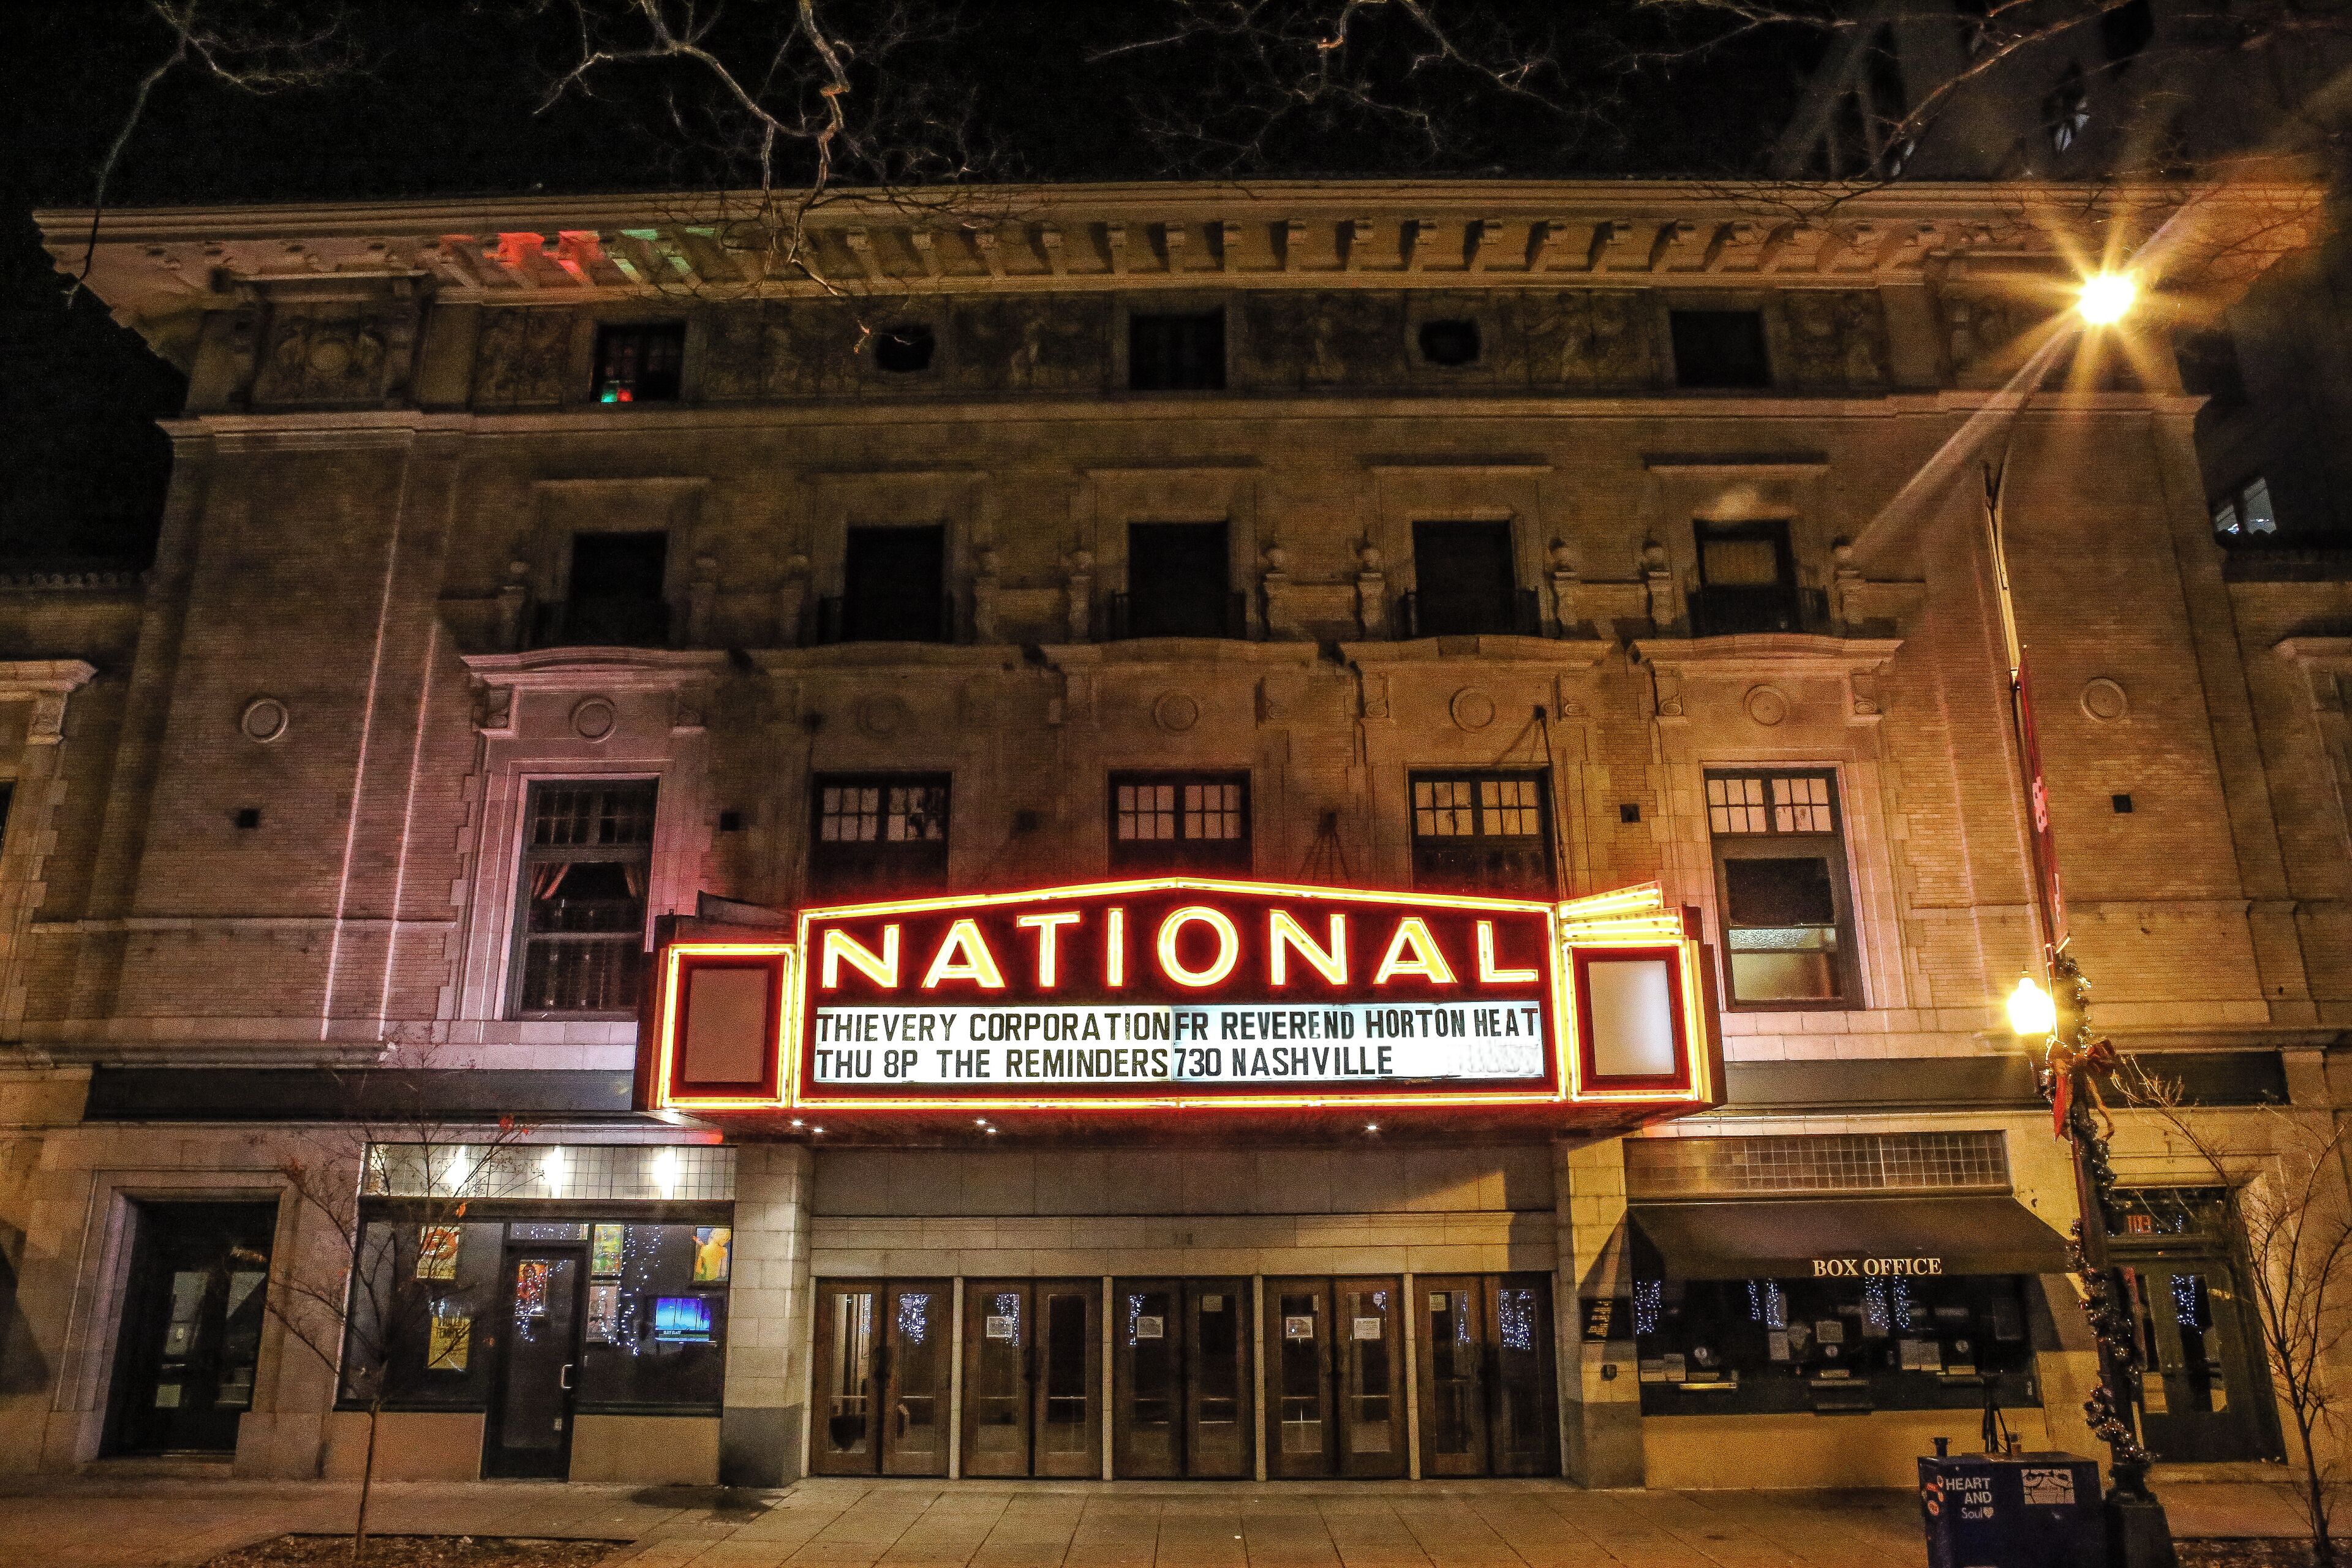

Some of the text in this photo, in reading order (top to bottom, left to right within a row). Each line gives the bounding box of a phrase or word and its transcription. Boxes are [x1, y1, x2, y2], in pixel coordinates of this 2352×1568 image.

[821, 905, 1539, 989] NATIONAL
[816, 1012, 1170, 1042] THIEVERY CORPORATION
[1175, 1008, 1539, 1040] FR REVEREND HORTON HEAT
[816, 1048, 1168, 1078] THU 8P THE REMINDERS
[1174, 1046, 1393, 1077] 730 NASHVILLE
[1812, 1257, 1942, 1276] BOX OFFICE
[1945, 1477, 1991, 1490] HEART
[1964, 1491, 1992, 1504] AND
